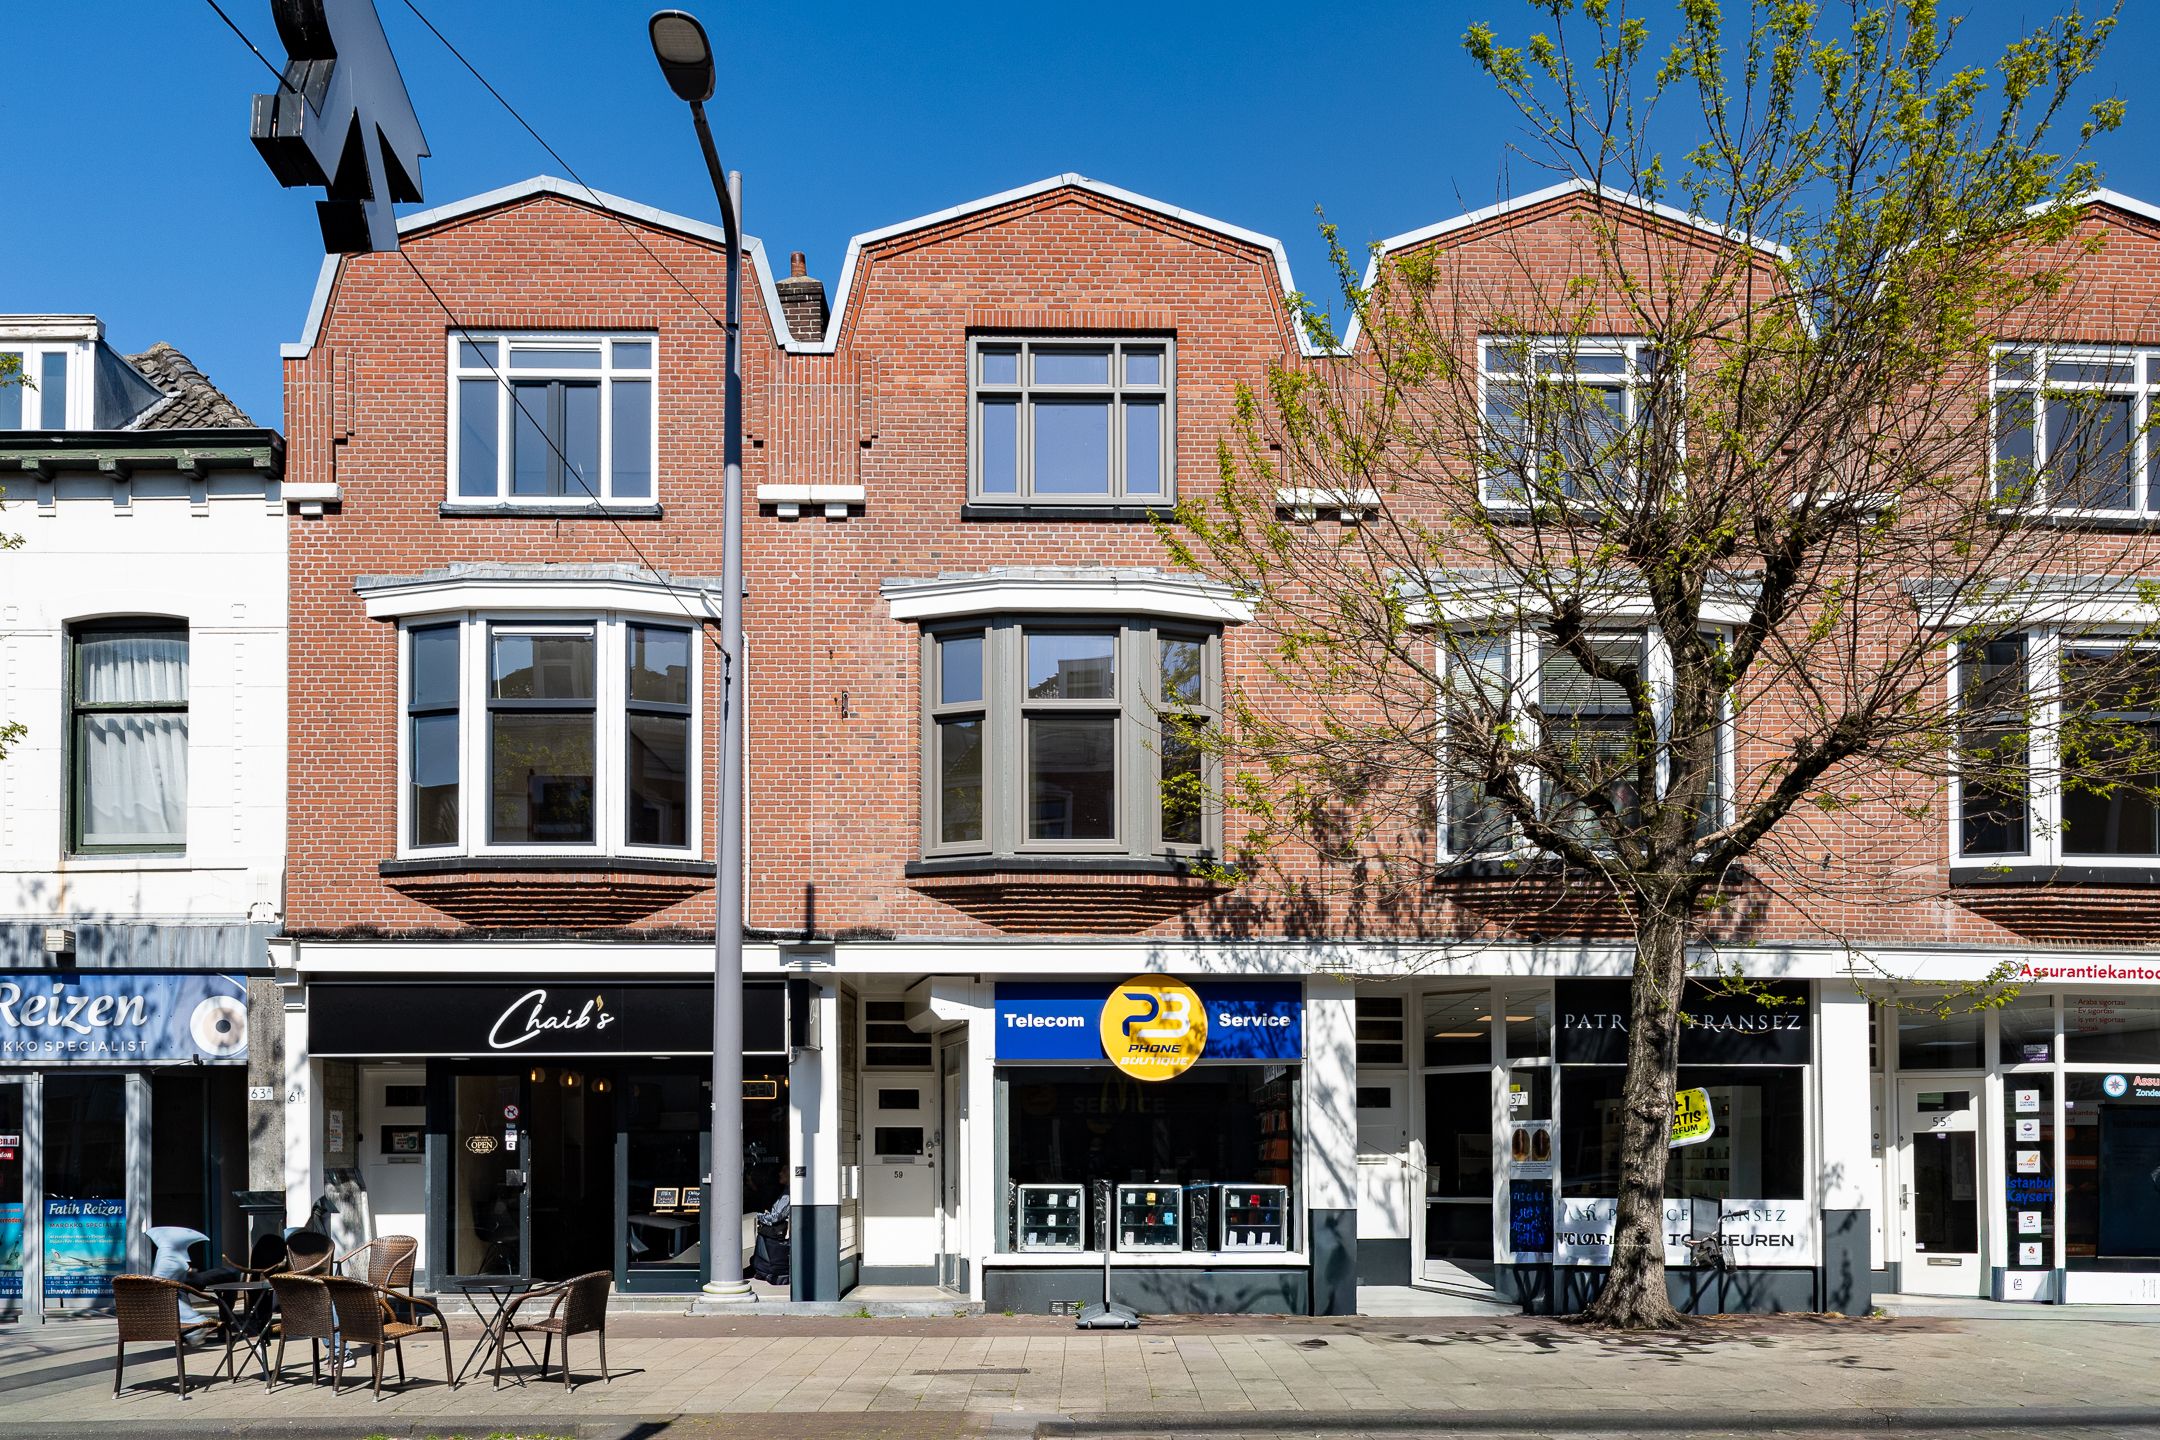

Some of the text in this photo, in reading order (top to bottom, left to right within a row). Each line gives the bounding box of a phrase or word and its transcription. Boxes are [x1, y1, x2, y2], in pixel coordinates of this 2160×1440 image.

[488, 989, 614, 1049] Chaib's
[1004, 1013, 1084, 1028] Telecom
[1219, 1013, 1291, 1027] Service
[1563, 1014, 1801, 1033] PATR FRANSEZ
[3, 1040, 147, 1052] KKO SPECIALIST
[1128, 1044, 1181, 1053] PHONE
[1119, 1056, 1190, 1066] BOUTIQUE
[1673, 1110, 1702, 1127] ATIS
[1672, 1124, 1699, 1135] RFUM
[471, 1141, 493, 1149] OPEN
[894, 1170, 904, 1179] 59
[49, 1203, 123, 1216] Fatih Reizen
[1724, 1209, 1786, 1222] ANSEZ
